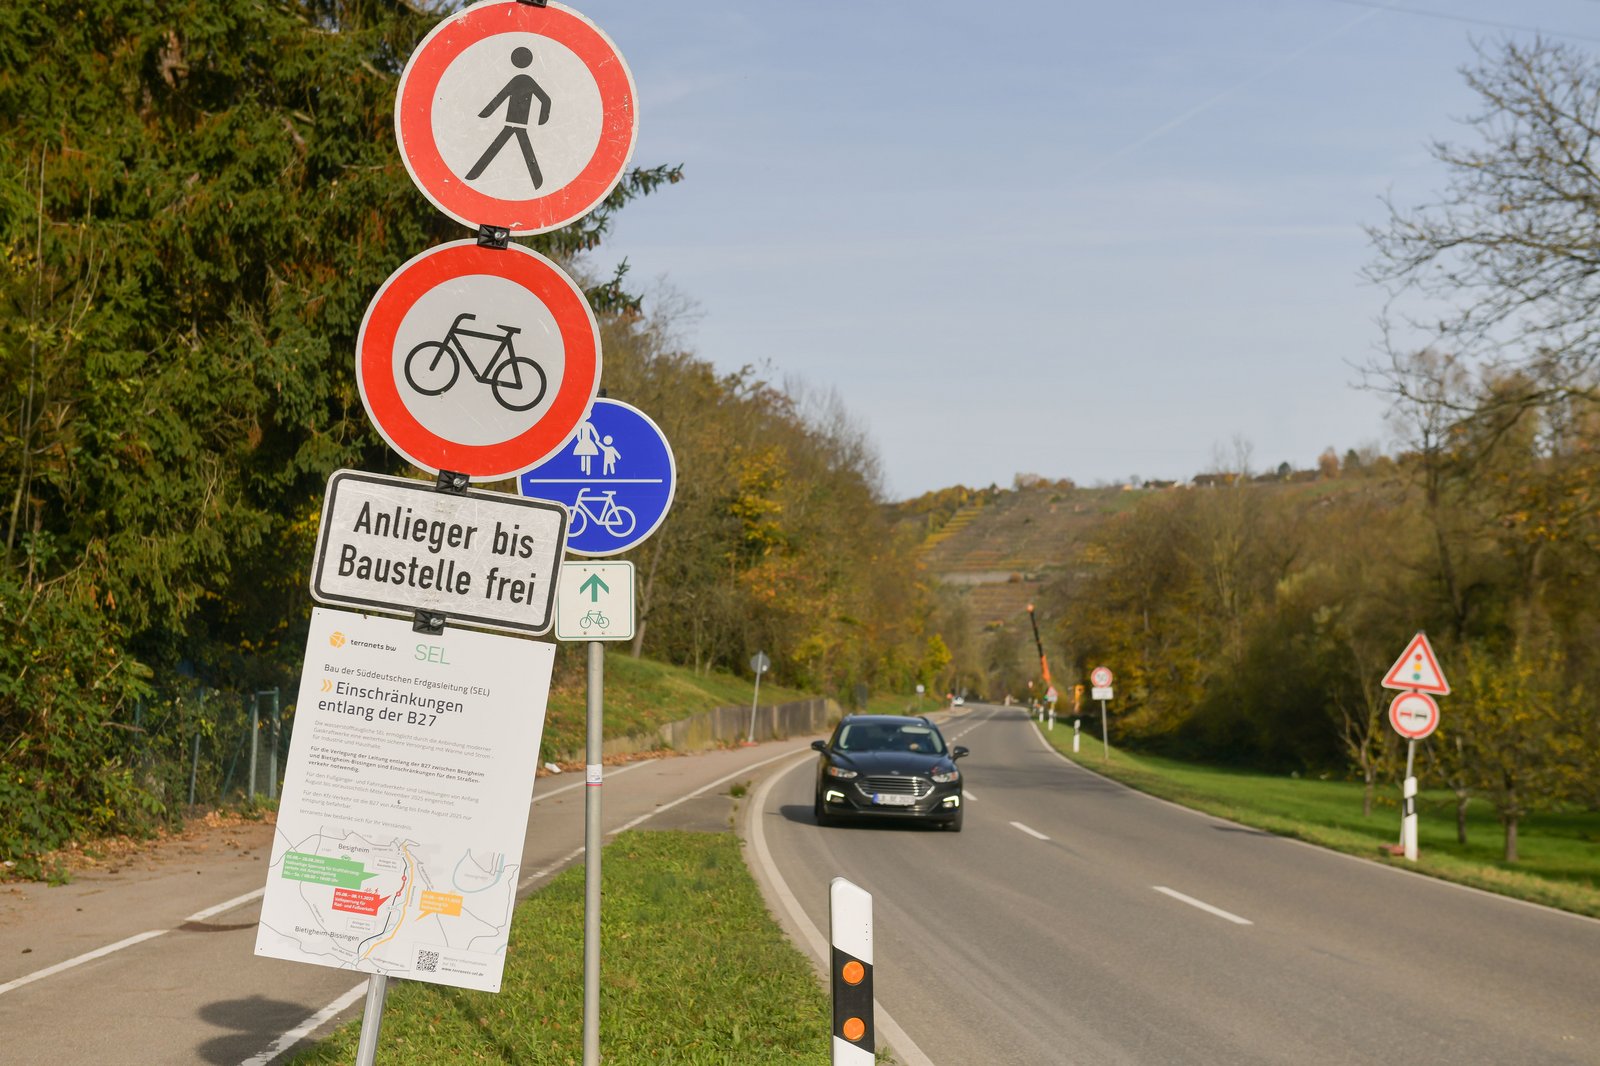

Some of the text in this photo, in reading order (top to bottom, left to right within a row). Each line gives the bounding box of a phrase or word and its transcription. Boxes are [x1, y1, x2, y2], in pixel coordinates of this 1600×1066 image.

[353, 501, 534, 558] Anlieger bis
[338, 544, 536, 605] Baustelle frei
[351, 640, 384, 650] terranets
[414, 644, 451, 665] SEL
[324, 664, 490, 697] Bau der Süddeutschen Erdgasleitung (SEL)
[336, 681, 463, 714] Einschränkungen
[318, 699, 437, 727] entlang der B27
[321, 754, 376, 768] Bietigheim-Bissingen
[390, 765, 436, 777] Einschränkungen
[330, 749, 357, 759] Verlegung
[368, 755, 389, 763] Leitung
[389, 759, 410, 767] entlang
[457, 769, 485, 777] Besigheim
[338, 843, 370, 853] Besigheim
[295, 926, 359, 942] Bietigheim-Bissingen
